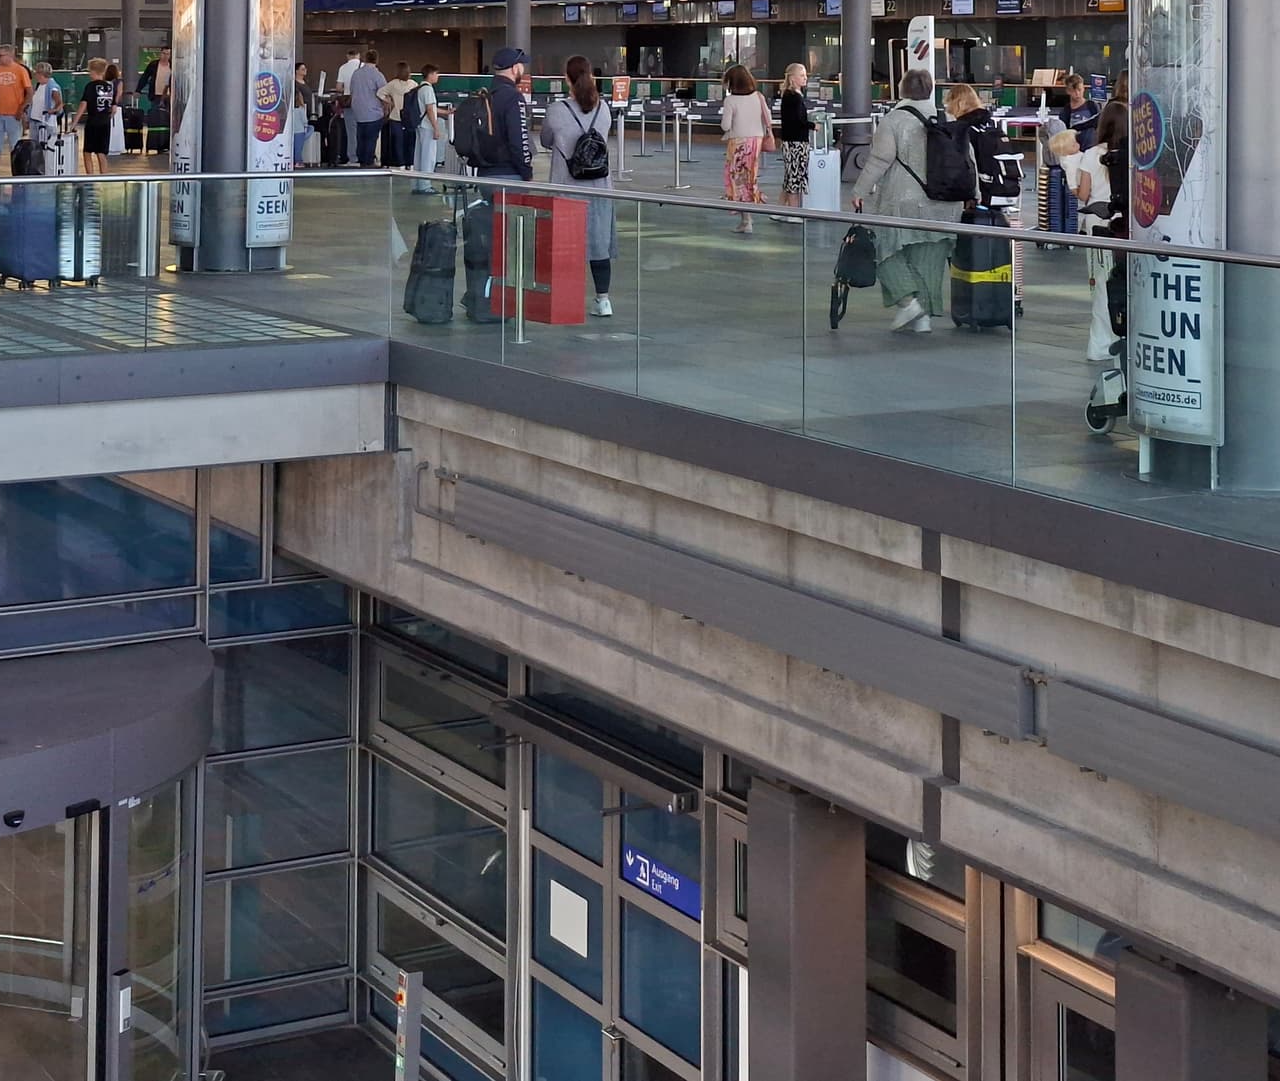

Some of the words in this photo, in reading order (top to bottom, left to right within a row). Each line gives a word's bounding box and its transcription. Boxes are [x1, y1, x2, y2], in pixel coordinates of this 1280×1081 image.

[886, 0, 896, 12] 22
[1150, 272, 1201, 302] THE
[651, 863, 680, 890] Ausgang
[651, 878, 663, 895] Exit
